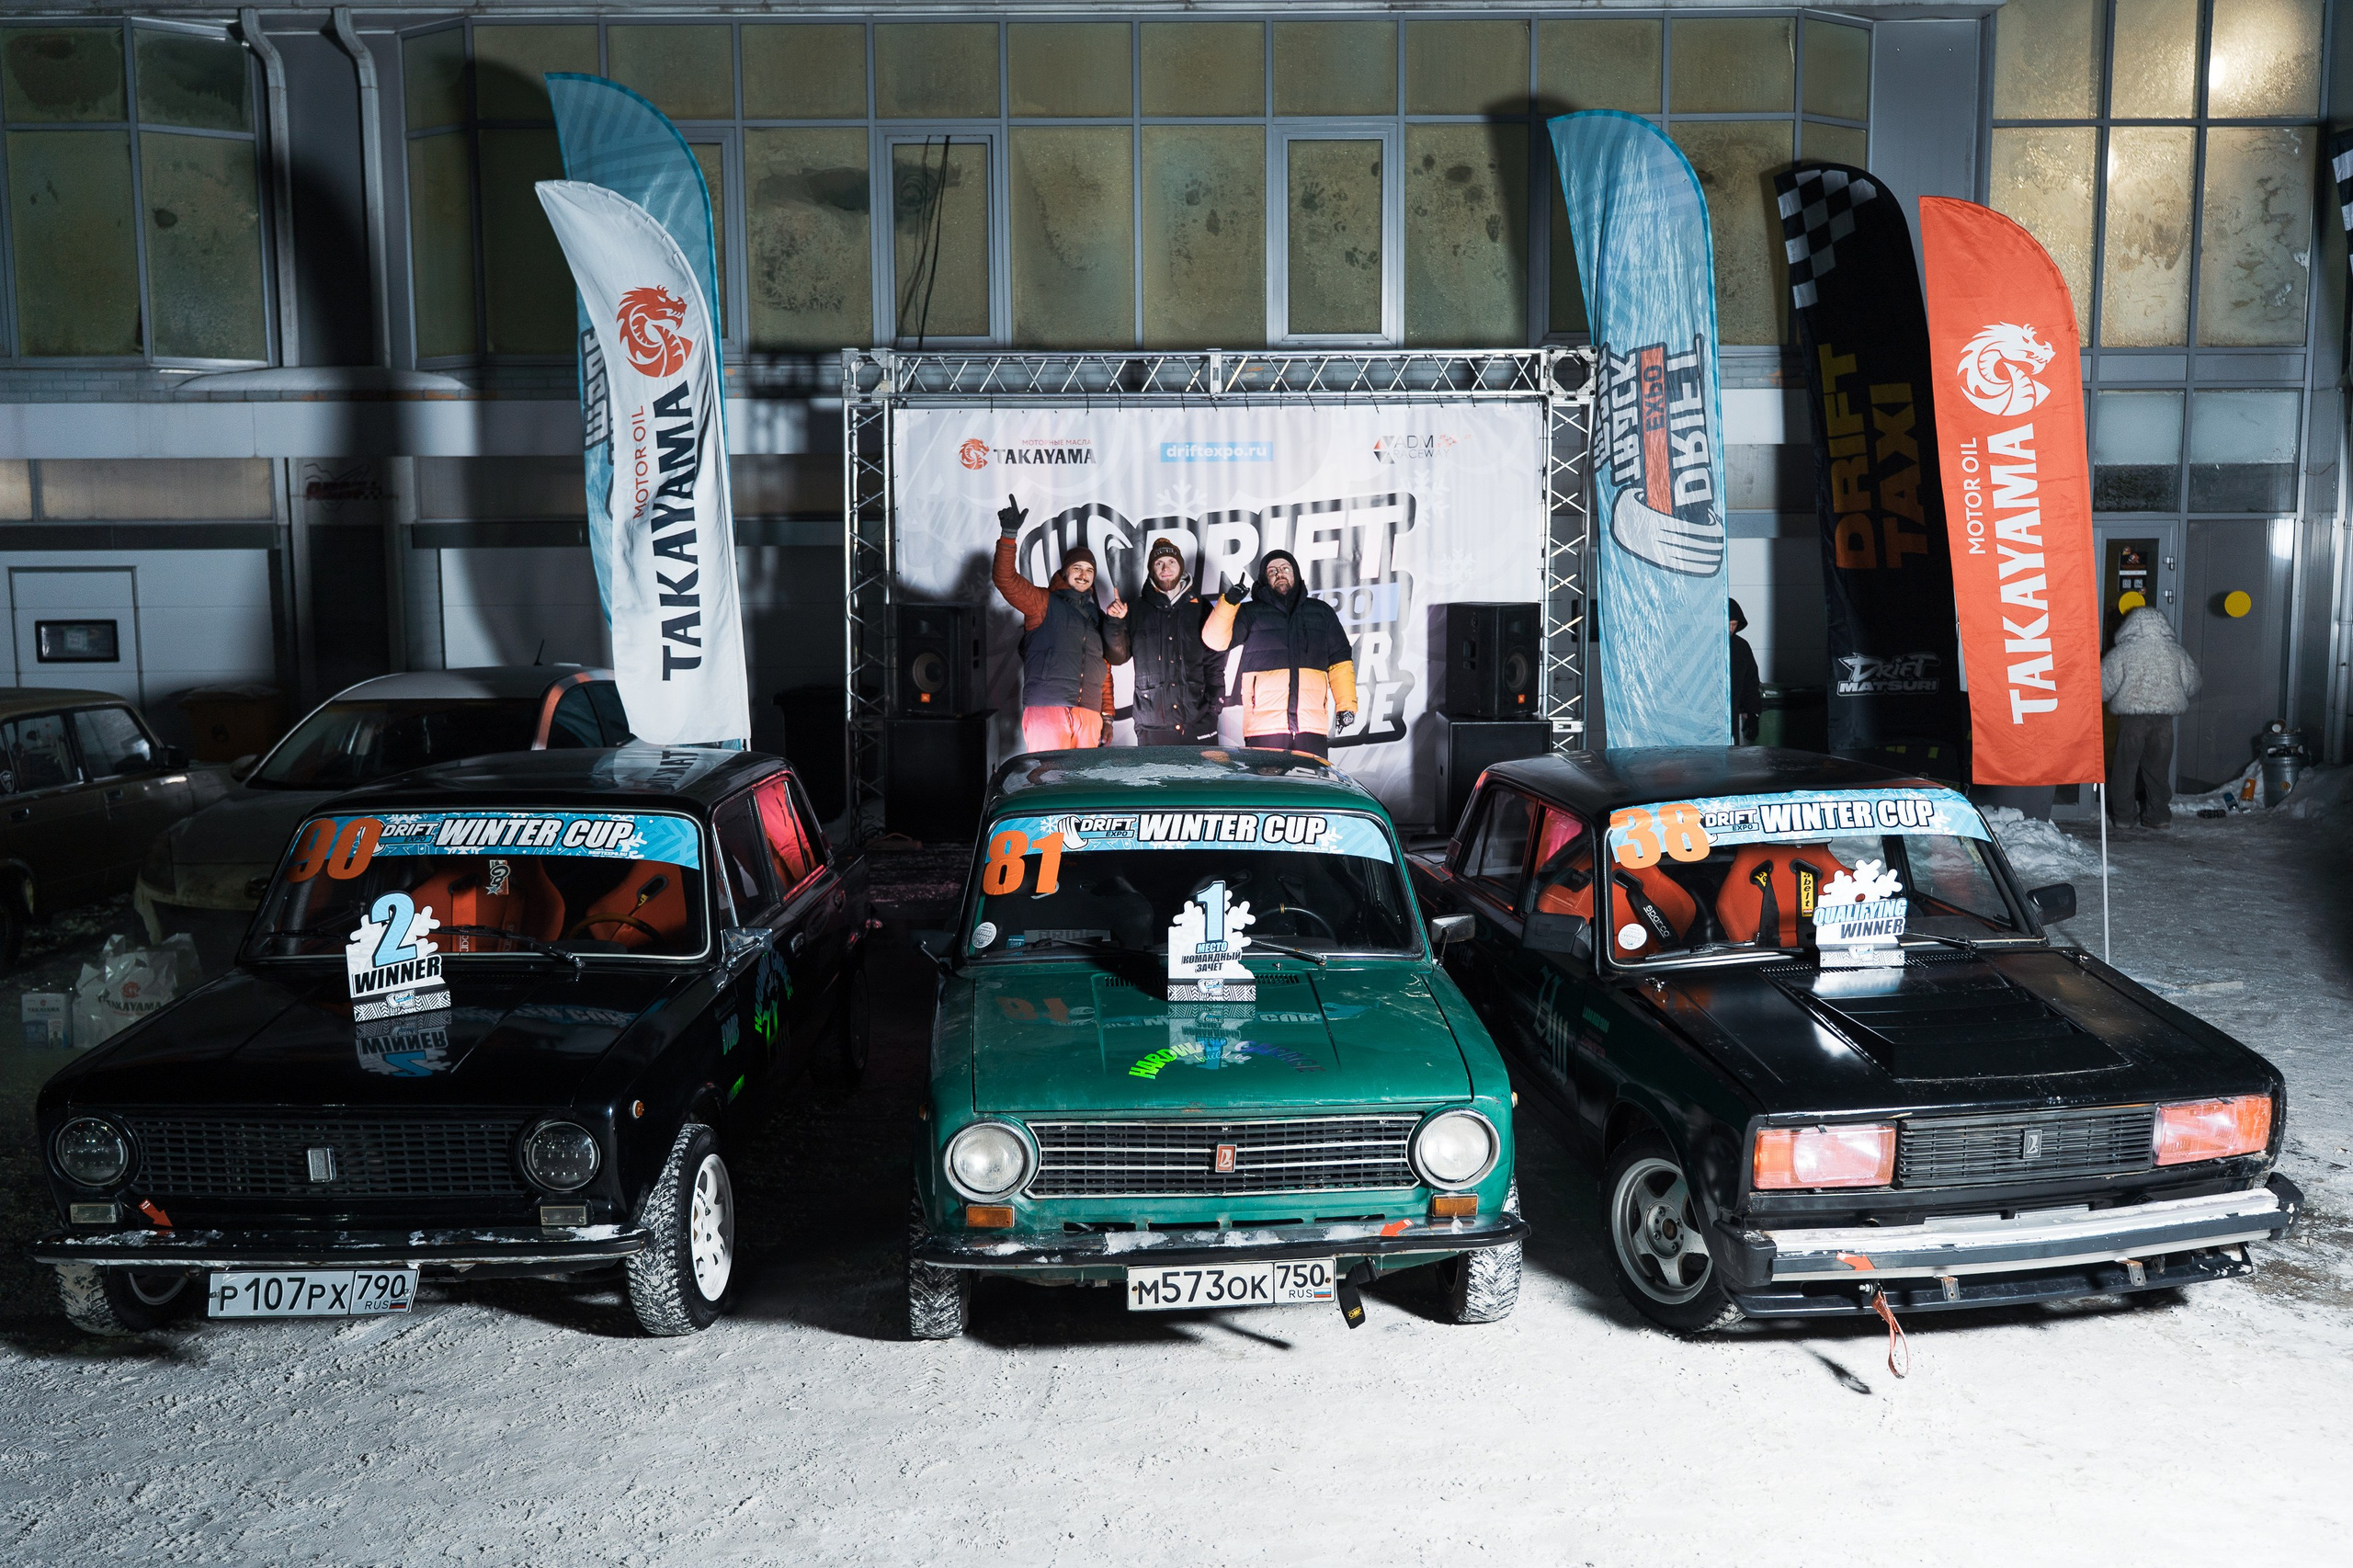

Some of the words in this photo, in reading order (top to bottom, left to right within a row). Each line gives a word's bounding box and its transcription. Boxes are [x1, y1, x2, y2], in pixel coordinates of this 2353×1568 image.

[631, 405, 648, 442] OIL
[994, 449, 1097, 464] TAKAYAMA
[1166, 445, 1267, 460] driftexpo.ru
[1393, 449, 1450, 459] RACEWAY
[1394, 435, 1434, 449] ADM
[1818, 343, 1878, 569] DRIFT
[1961, 437, 1978, 475] OIL
[633, 449, 649, 519] MOTOR
[1869, 382, 1928, 569] TAXI
[652, 380, 702, 681] TAKAYAMA
[1964, 483, 1986, 555] MOTOR
[1988, 422, 2057, 724] TAKAYAMA
[1839, 680, 1937, 693] MATSURI
[381, 823, 440, 836] DRIFT
[1080, 817, 1137, 832] DRIFT
[1137, 813, 1259, 842] WINTER
[1262, 814, 1327, 845] CUP
[1705, 809, 1757, 827] DRIFT
[1758, 801, 1875, 834] WINTER
[1877, 800, 1935, 827] CUP
[434, 818, 564, 846] WINTER
[562, 819, 634, 849] CUP
[1609, 803, 1710, 869] 38
[286, 818, 382, 882] 90
[983, 830, 1064, 895] 81
[1803, 872, 1812, 907] abelt
[1196, 881, 1225, 941] 1
[1643, 905, 1670, 937] sparco
[1813, 898, 1907, 926] QUALIFYING
[369, 891, 417, 968] 2
[1840, 918, 1904, 938] WINNER
[1181, 950, 1242, 965] КОМАНДНЫЙ
[1196, 941, 1228, 953] МЕСТО
[354, 956, 440, 994] WINNER
[1196, 962, 1223, 973] ЗАЧЕТ
[358, 1274, 406, 1300] 790
[1277, 1264, 1325, 1290] 750
[364, 1301, 389, 1311] RUS
[1289, 1290, 1313, 1299] RUS
